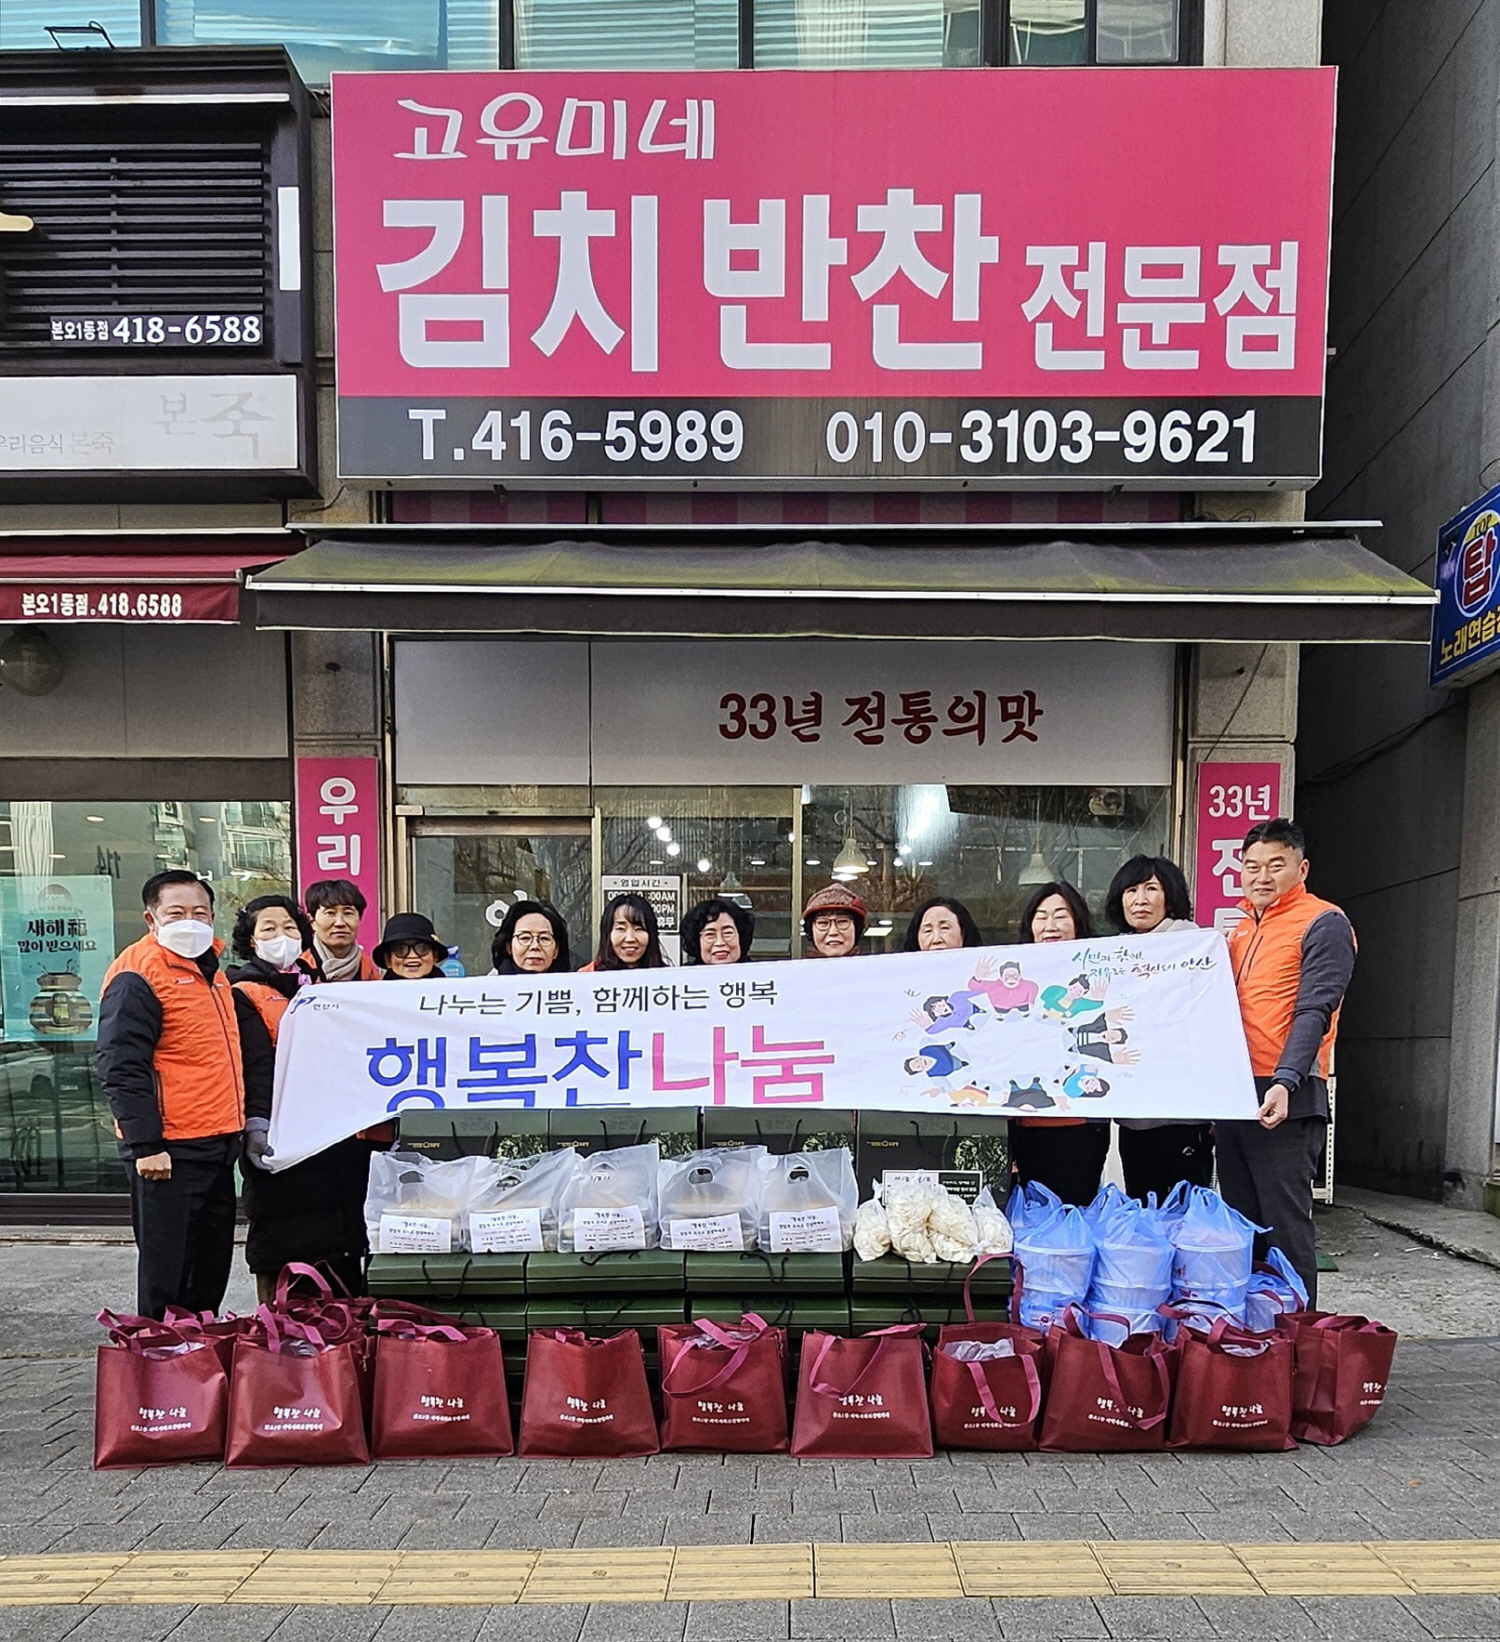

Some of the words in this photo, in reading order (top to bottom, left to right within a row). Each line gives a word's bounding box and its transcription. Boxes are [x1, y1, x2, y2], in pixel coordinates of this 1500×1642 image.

[393, 91, 717, 160] 고유미네
[375, 190, 659, 372] 김치
[702, 188, 999, 371] 반찬
[1020, 240, 1299, 371] 전문점
[51, 319, 109, 341] 본오1동점
[112, 314, 262, 344] 418-6588
[153, 391, 275, 460] 본죽
[826, 408, 1256, 464] 010-3103-9621
[1473, 514, 1493, 537] TOP
[1462, 526, 1499, 610] 탑
[1439, 604, 1500, 666] 노래연습
[718, 690, 823, 744] 33년
[1208, 784, 1271, 821] 33년
[620, 878, 661, 887] 영업시간
[17, 939, 44, 954] 많이
[46, 939, 97, 954] 받으세요
[26, 918, 64, 938] 새해
[67, 918, 88, 938] 福
[1131, 963, 1176, 980] 혁신도시
[1180, 956, 1217, 971] 안산
[418, 992, 508, 1016] 나누는
[514, 988, 581, 1018] 기쁨,
[591, 984, 710, 1013] 함께하는
[718, 979, 779, 1009] 행복
